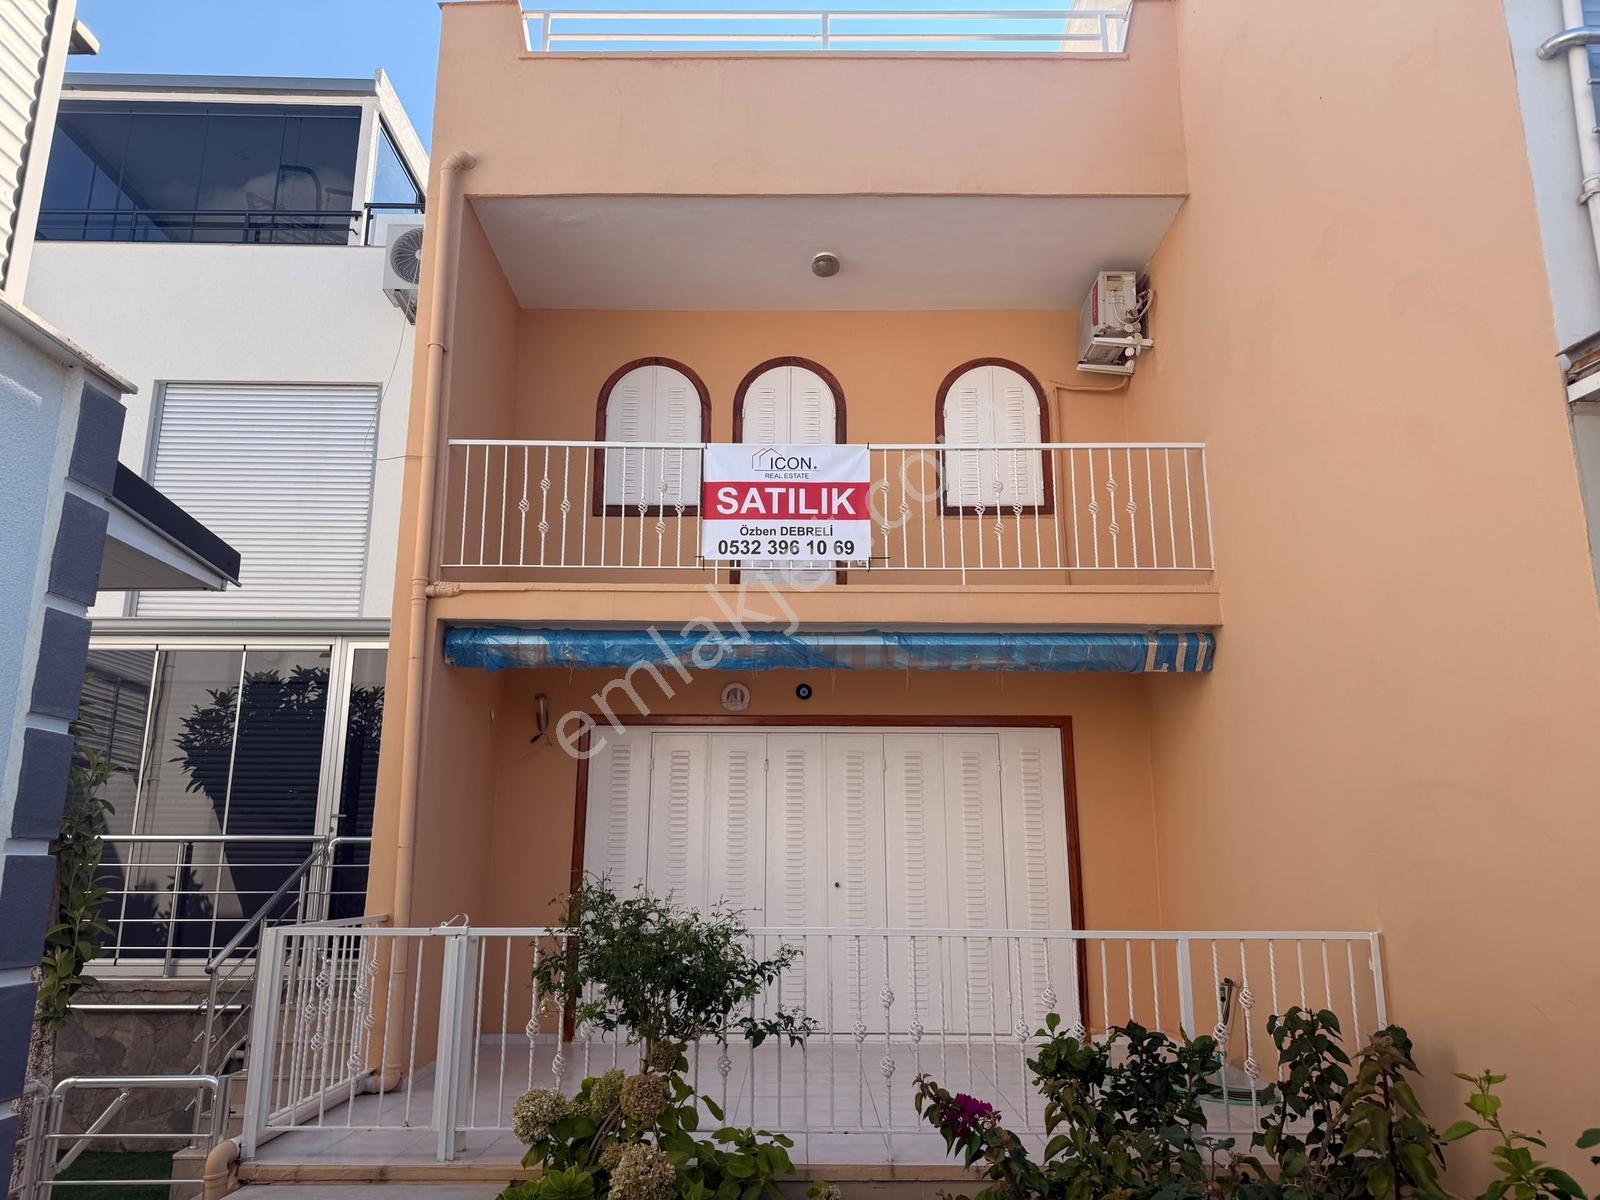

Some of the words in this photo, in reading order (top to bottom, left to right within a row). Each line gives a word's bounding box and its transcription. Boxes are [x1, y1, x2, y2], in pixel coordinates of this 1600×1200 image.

[764, 472, 783, 480] REAL
[783, 472, 810, 480] ESTATE
[716, 486, 856, 515] SATILIK
[739, 524, 777, 537] Özben
[780, 525, 833, 537] DEBRELİ
[718, 539, 761, 555] 0532
[767, 539, 800, 555] 396
[806, 540, 827, 555] 10
[833, 540, 855, 555] 69
